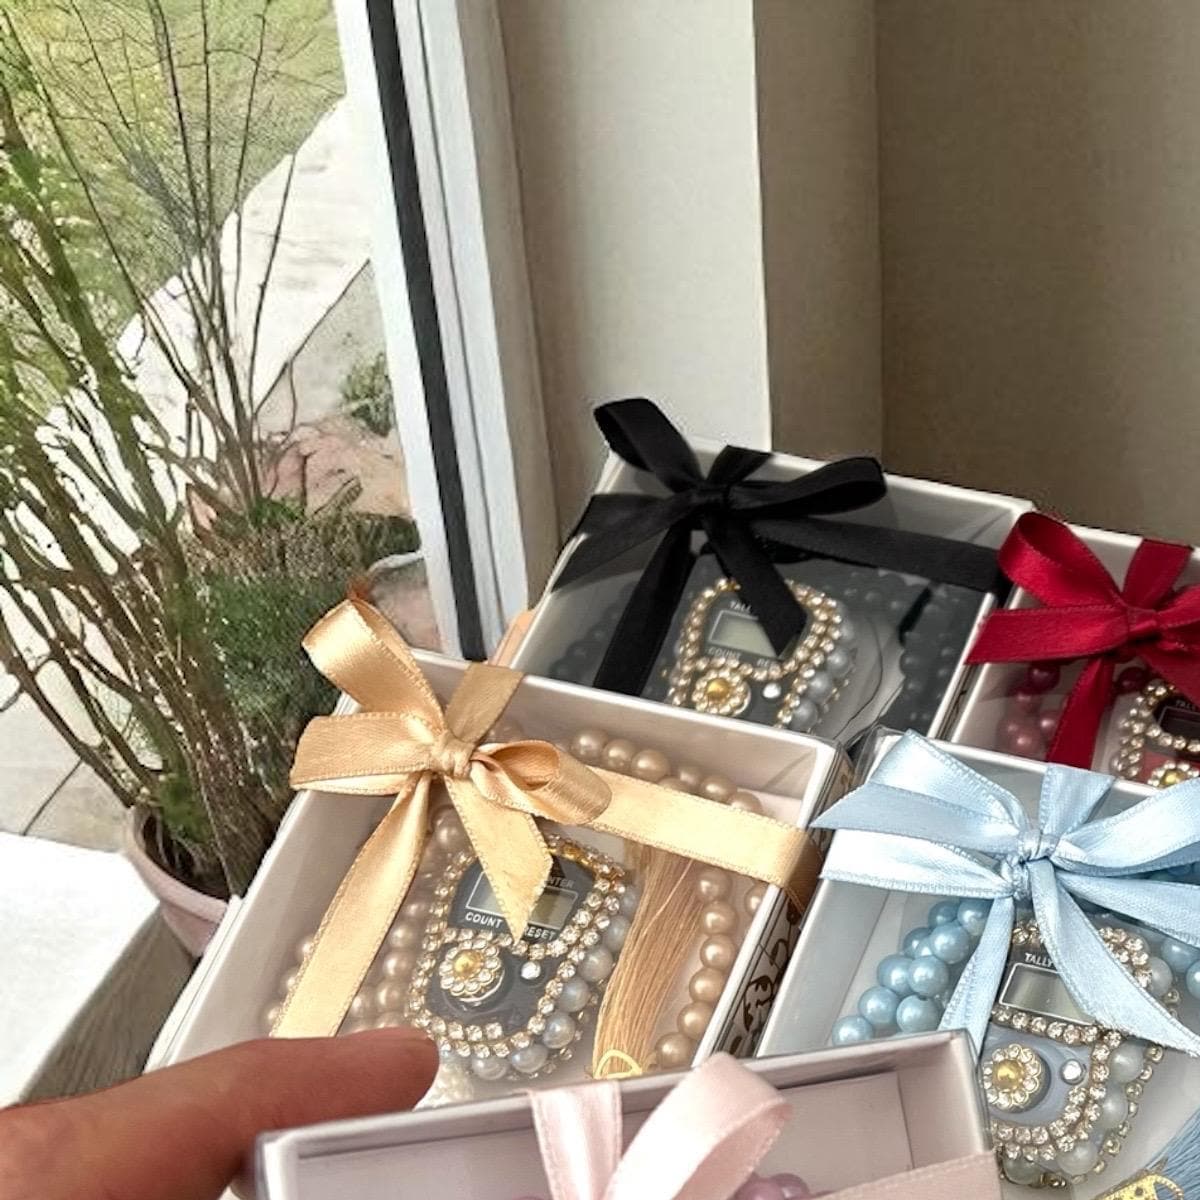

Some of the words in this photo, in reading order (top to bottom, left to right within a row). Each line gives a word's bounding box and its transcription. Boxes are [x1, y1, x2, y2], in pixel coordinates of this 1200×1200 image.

[729, 600, 752, 613] TALL
[465, 911, 503, 929] COUNT
[1024, 952, 1054, 968] TALLY
